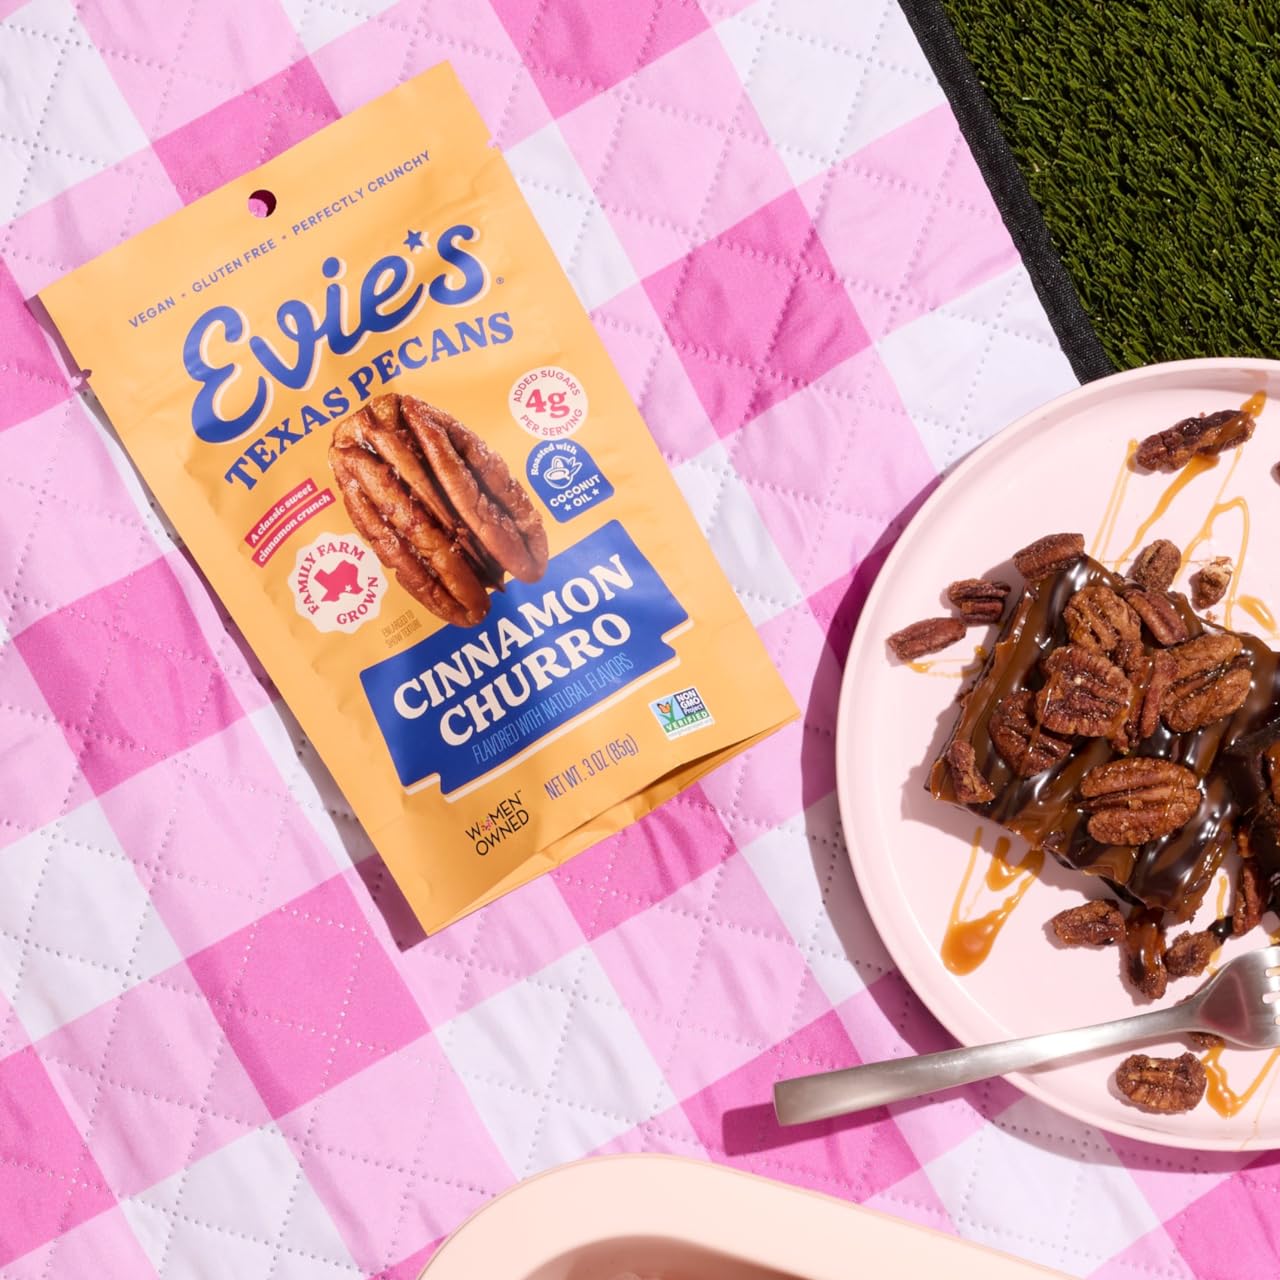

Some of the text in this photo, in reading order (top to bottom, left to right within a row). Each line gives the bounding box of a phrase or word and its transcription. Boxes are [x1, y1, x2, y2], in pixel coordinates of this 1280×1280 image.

[128, 150, 431, 328] VEGAN GLUTEN FREE PERFECTLY CRUNCHY
[225, 311, 515, 490] TEXAS PECANS
[513, 369, 581, 403] ADDED SUGARS
[525, 389, 570, 419] 4g
[520, 408, 583, 436] PER SERVING
[530, 442, 578, 476] Roasted with
[251, 483, 314, 544] A classic sweet
[550, 474, 601, 507] COCONUT
[573, 495, 593, 507] OIL
[258, 494, 331, 563] cinnamon crunch
[297, 541, 366, 615] FAMILY FARM
[336, 576, 379, 625] GROWN
[393, 553, 634, 720] CINNAMON
[439, 612, 632, 747] CHURRO
[675, 689, 697, 702] NON
[680, 697, 700, 709] GMO
[471, 651, 635, 765] FLAVORED WITH NATURAL FLAVORS
[665, 711, 708, 731] VERIFIED
[543, 733, 639, 801] NET WT. 3 OZ (85g)
[475, 809, 529, 856] OWNED
